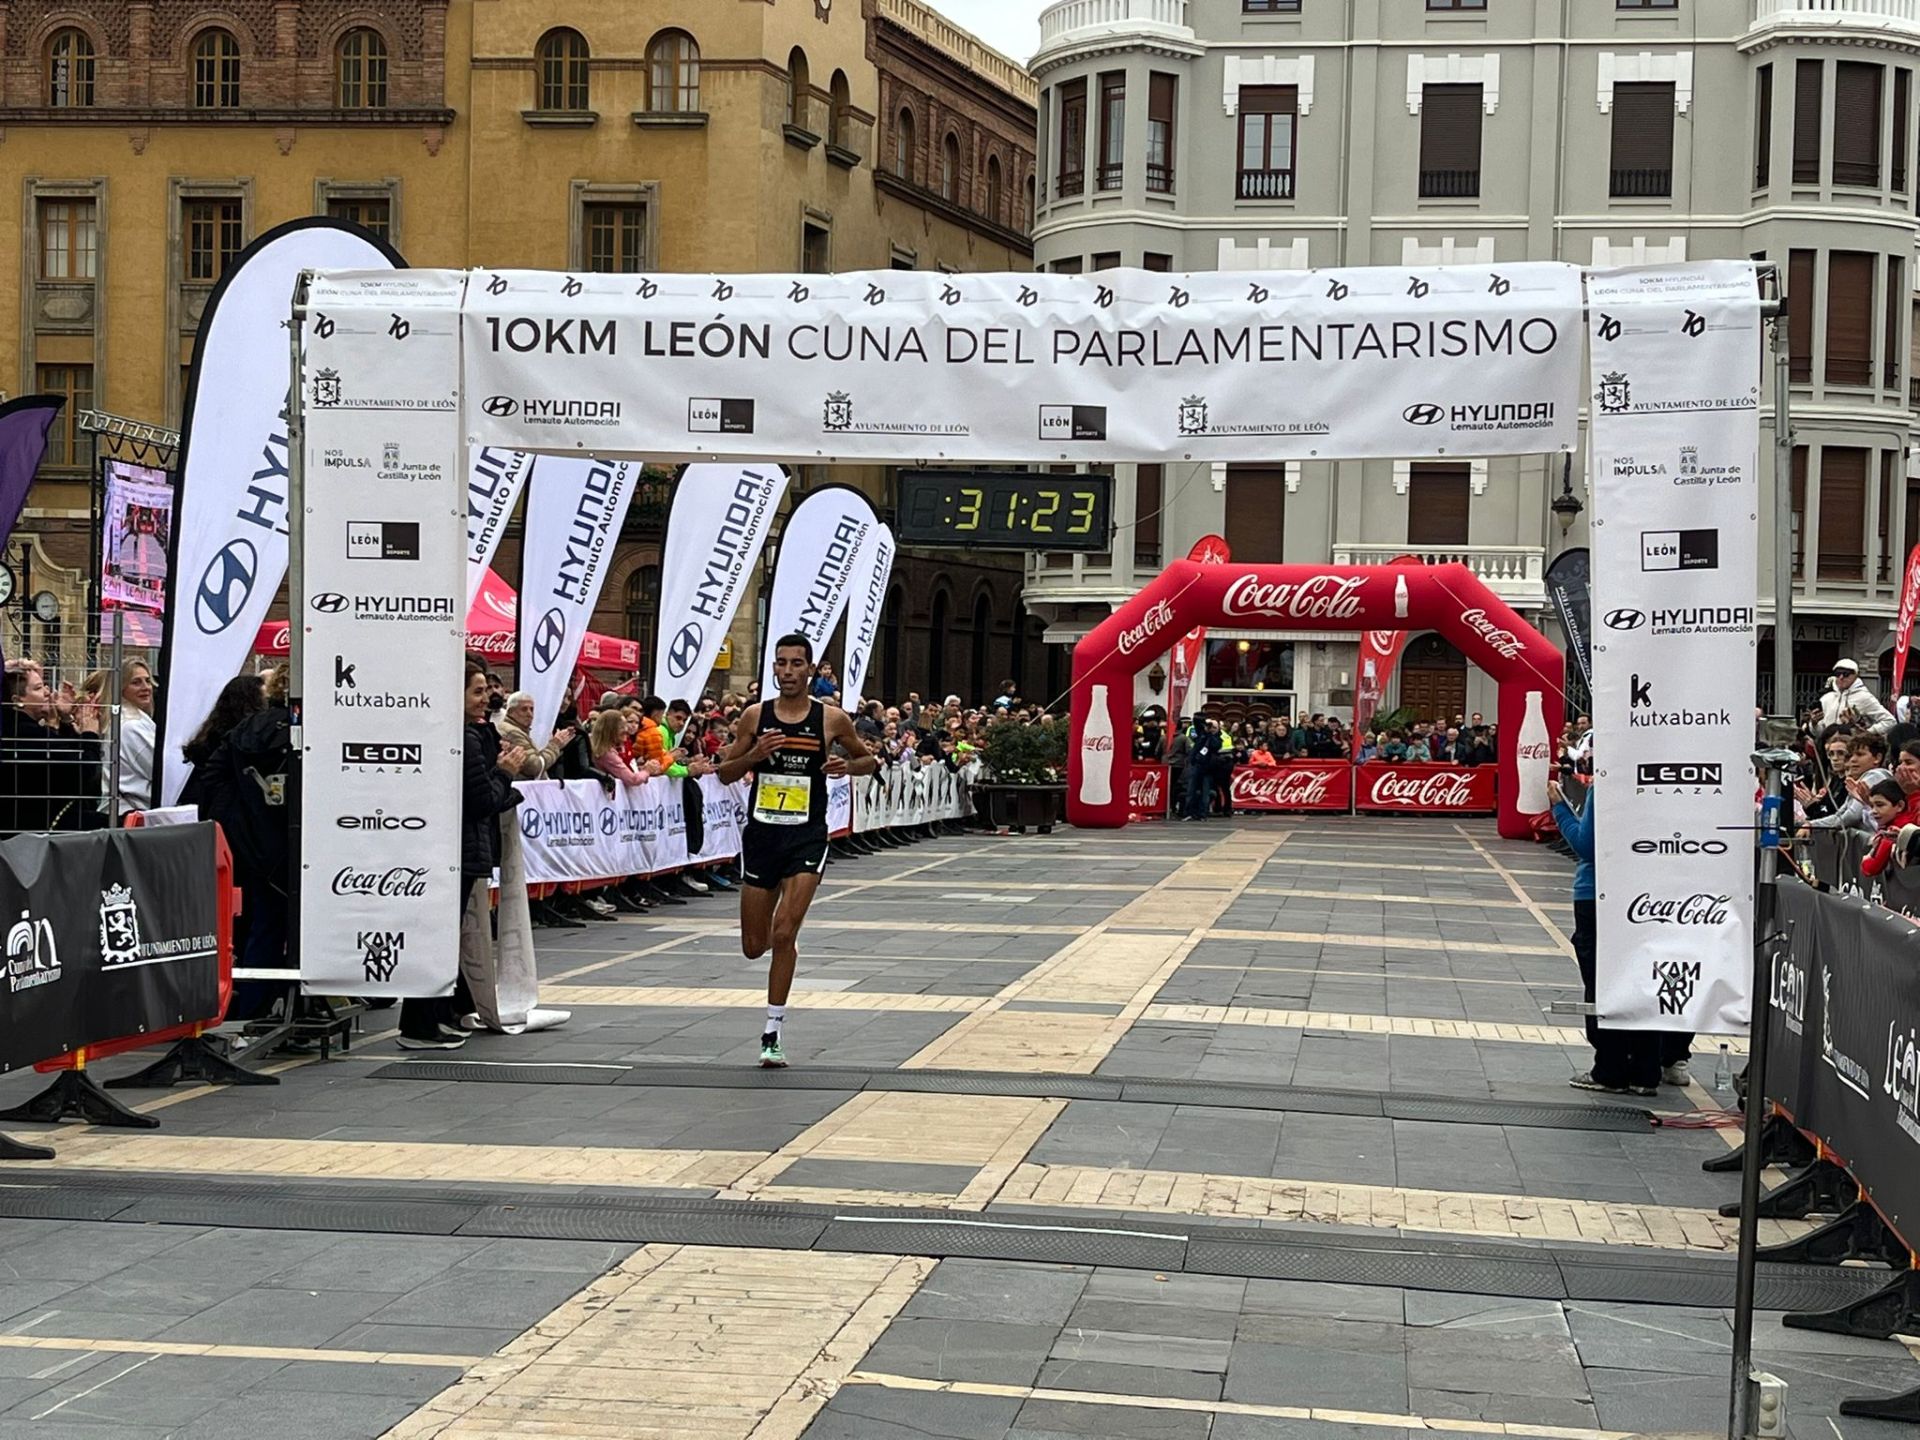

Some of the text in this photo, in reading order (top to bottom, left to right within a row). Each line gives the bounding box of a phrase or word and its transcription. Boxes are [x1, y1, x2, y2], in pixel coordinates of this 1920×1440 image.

[487, 313, 1558, 367] 10KM LEÓN CUNA DEL PARLAMENTARISMO
[344, 399, 456, 408] AYUNTAMIENTO DE LEÓN
[524, 400, 621, 418] HYUNDAI
[1633, 397, 1757, 411] AYUNTAMIENTO DE LEÓN
[693, 408, 719, 420] LEÓN
[1451, 402, 1554, 422] HYUNDAI
[524, 417, 621, 427] Lemauto Automoción
[855, 423, 970, 433] AYUNTAMIENTO DE LEÓN
[1043, 415, 1070, 427] LEÓN
[1210, 421, 1330, 433] AYUNTAMIENTO DE LEÓN
[1451, 419, 1554, 431] Lemauto Automoción
[325, 449, 344, 457] NOS
[1614, 456, 1634, 464] NOS
[325, 458, 371, 470] IMPULSA
[401, 463, 440, 471] Junta de
[1614, 463, 1668, 477] IMPULSA
[1701, 465, 1741, 475] Junta de
[377, 472, 441, 482] Castilla y León
[1674, 474, 1741, 487] Castilla y León
[468, 487, 510, 564] Lemauto
[575, 537, 605, 605] Lemauto
[598, 461, 629, 534] Automoc
[351, 532, 380, 545] LEÓN
[691, 469, 764, 616] HYUNDAI
[713, 478, 775, 620] Lemauto Automoción
[1647, 543, 1677, 556] LEÓN
[794, 514, 860, 639] HYUNDAI
[812, 522, 869, 642] Lemauto Automoción
[857, 541, 889, 643] HYUNDAI
[355, 596, 454, 613] HYUNDAI
[1223, 575, 1371, 628] Coca-Cola
[355, 613, 455, 622] Lemauto Automoción
[1652, 608, 1753, 627] HYUNDAI
[1117, 597, 1174, 656] Coca-Cola
[1460, 608, 1527, 659] Coca-Cola
[1652, 626, 1692, 636] Lemauto
[1695, 624, 1754, 634] Automoción
[335, 691, 430, 709] kutxabank
[1630, 708, 1731, 727] kutxabank
[345, 746, 420, 761] LEON
[781, 755, 810, 764] VICKY
[342, 766, 423, 774] PLAZA
[1640, 767, 1720, 782] LEON
[1231, 769, 1332, 806] Coca-Cola
[1372, 770, 1475, 806] Coca-Cola
[1637, 787, 1722, 795] PLAZA
[777, 791, 787, 811] 7
[336, 809, 426, 830] emico
[1631, 833, 1728, 856] emico
[332, 866, 430, 897] Coca-Cola
[1626, 893, 1731, 925] Coca-Cola
